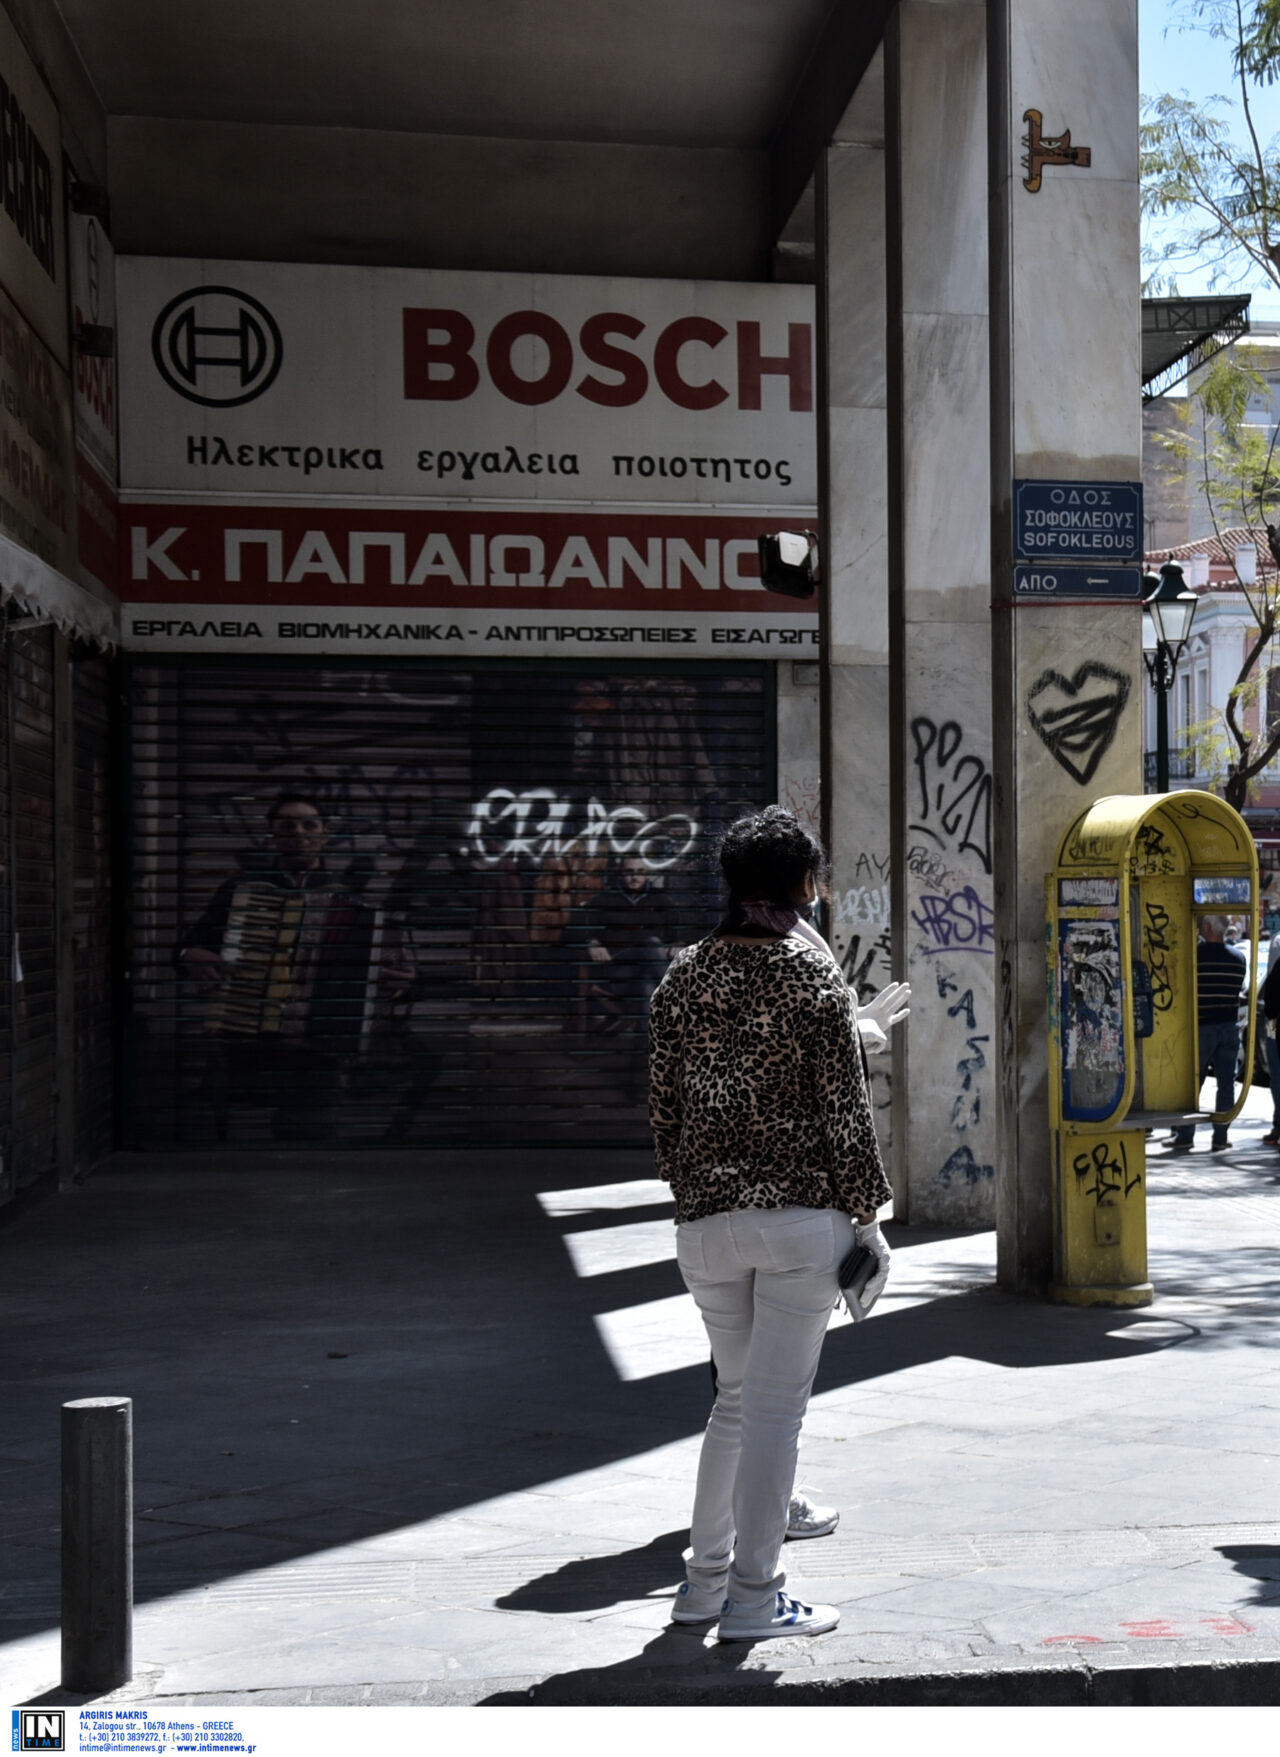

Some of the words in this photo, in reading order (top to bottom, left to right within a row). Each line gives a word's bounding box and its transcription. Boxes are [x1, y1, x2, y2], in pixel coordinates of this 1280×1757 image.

[0, 73, 56, 284] ECKER
[402, 307, 813, 412] BOSCH
[186, 435, 384, 475] Ηλεκτρικα
[417, 446, 579, 479] εργαλεια
[612, 455, 792, 485] ποιοτητος
[1050, 489, 1112, 505] ΟΔΟΣ
[1024, 510, 1134, 529] ΣΟΦΟΚΛΕΟΥΣ
[1023, 532, 1135, 549] SOFOKLEOUS
[131, 526, 199, 581] Κ.
[224, 528, 819, 591] ΠΑΠΑΙΩΑΝΝΟ
[1019, 575, 1057, 590] ΑΠΟ
[132, 620, 262, 637] ΕΡΓΑΛΕΙΑ
[278, 622, 464, 640] ΒΙΟΜΗΧΑΝΙΚΑ
[485, 625, 697, 643] ΑΝΤΙΠΡΟΣΩΠΕΙΕΣ
